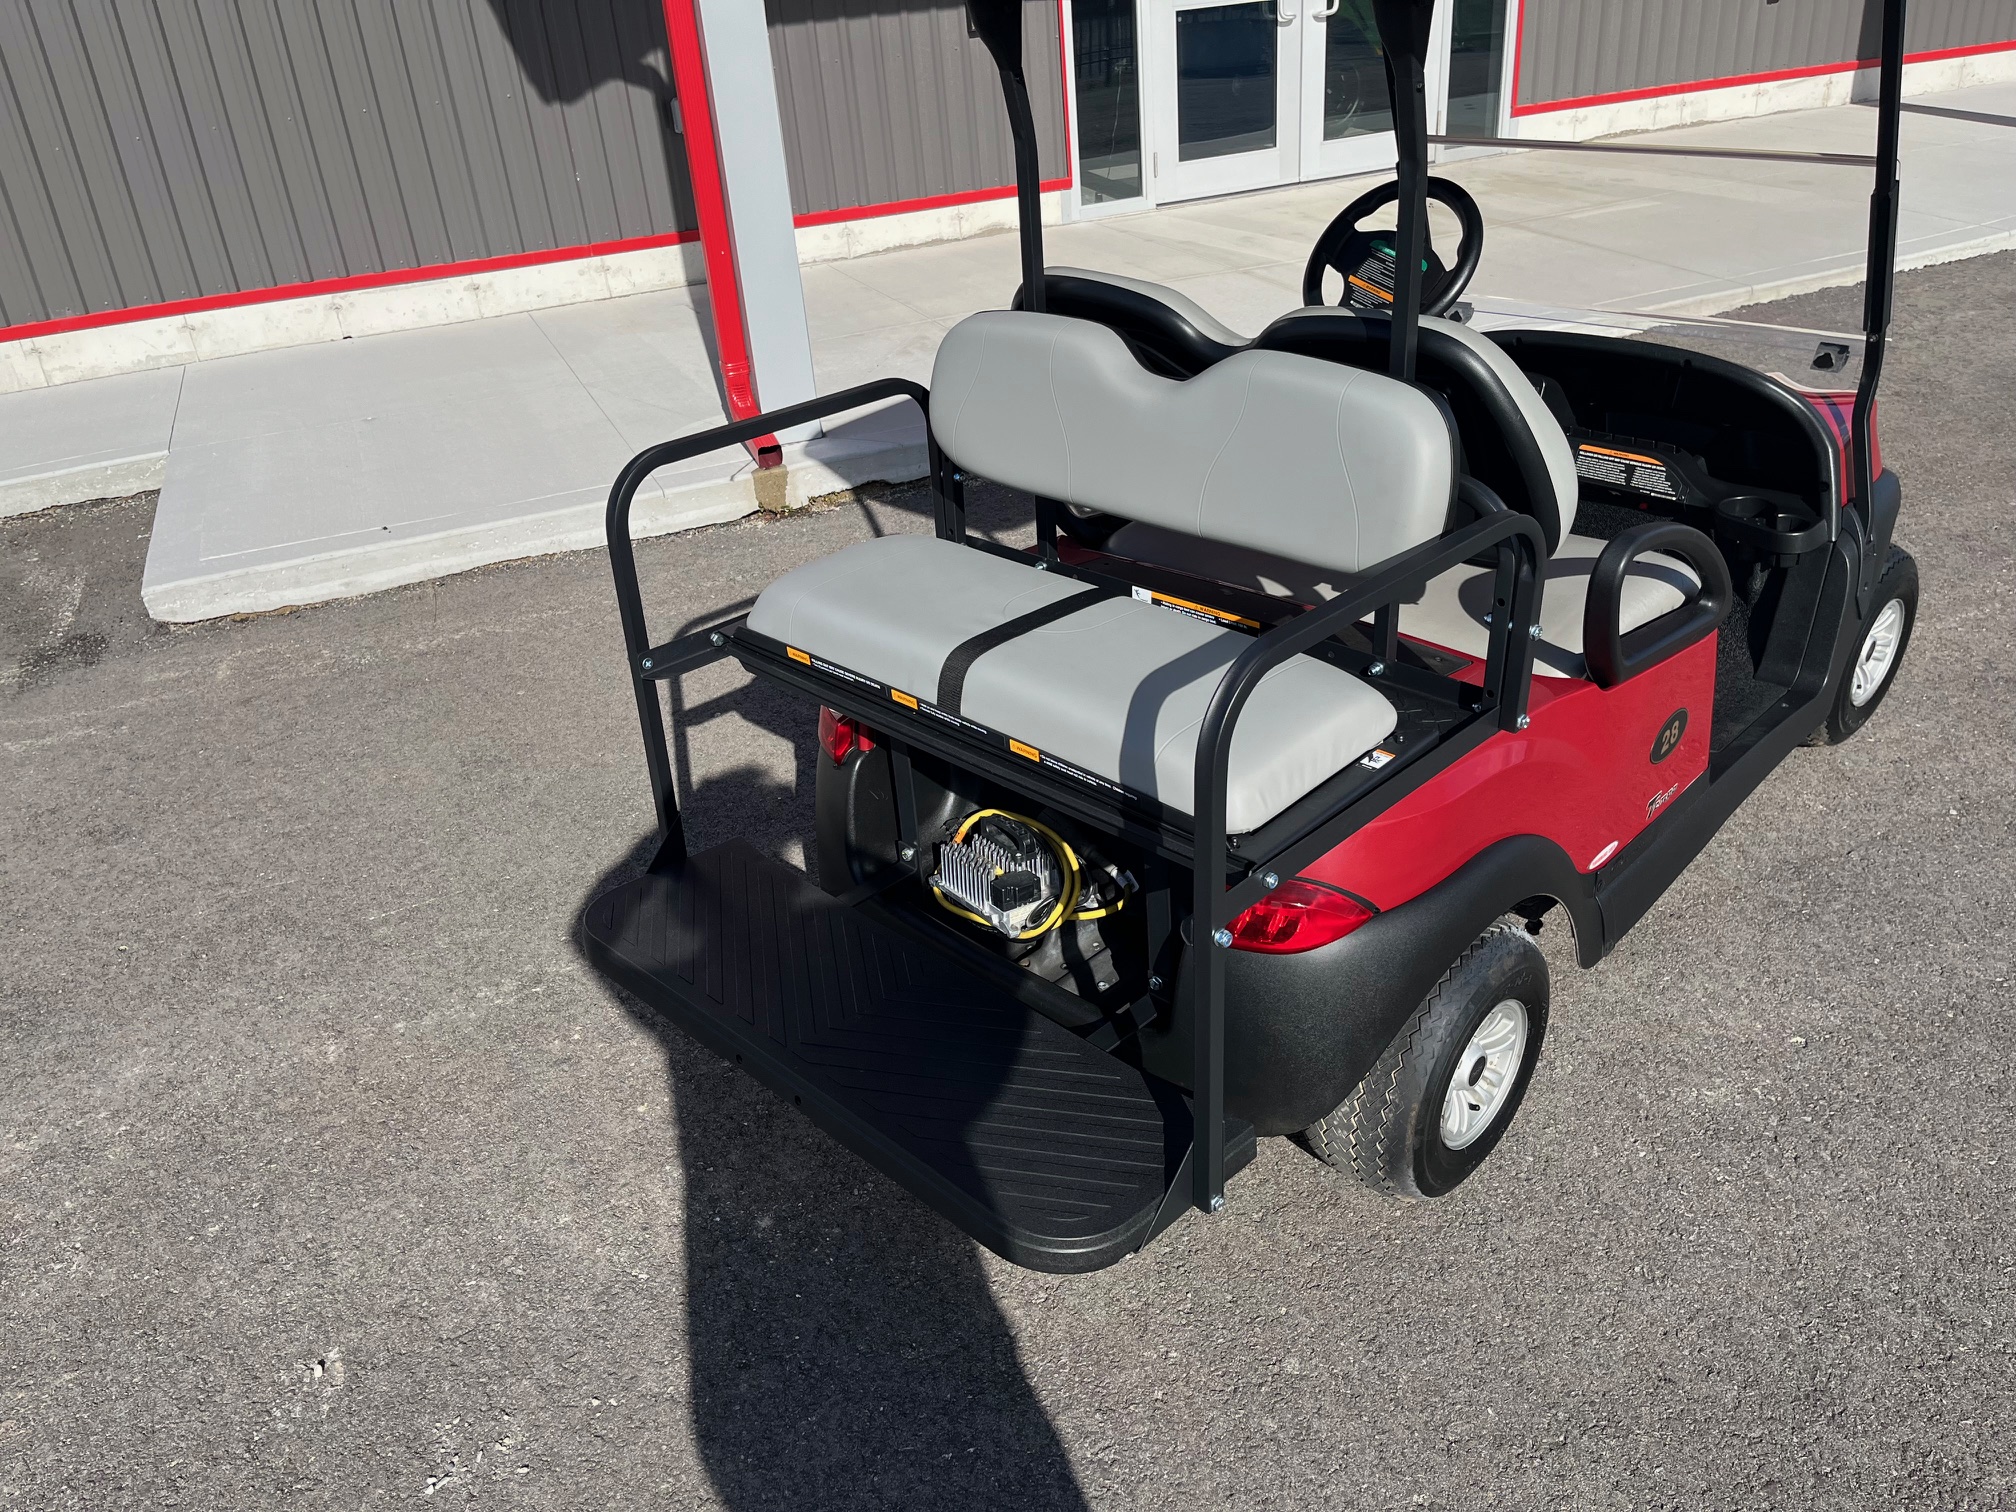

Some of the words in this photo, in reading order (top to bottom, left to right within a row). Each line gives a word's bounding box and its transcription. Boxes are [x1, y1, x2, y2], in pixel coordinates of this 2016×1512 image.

[1199, 607, 1221, 616] WARNING
[1660, 720, 1679, 755] 28
[1017, 747, 1037, 758] WARNING
